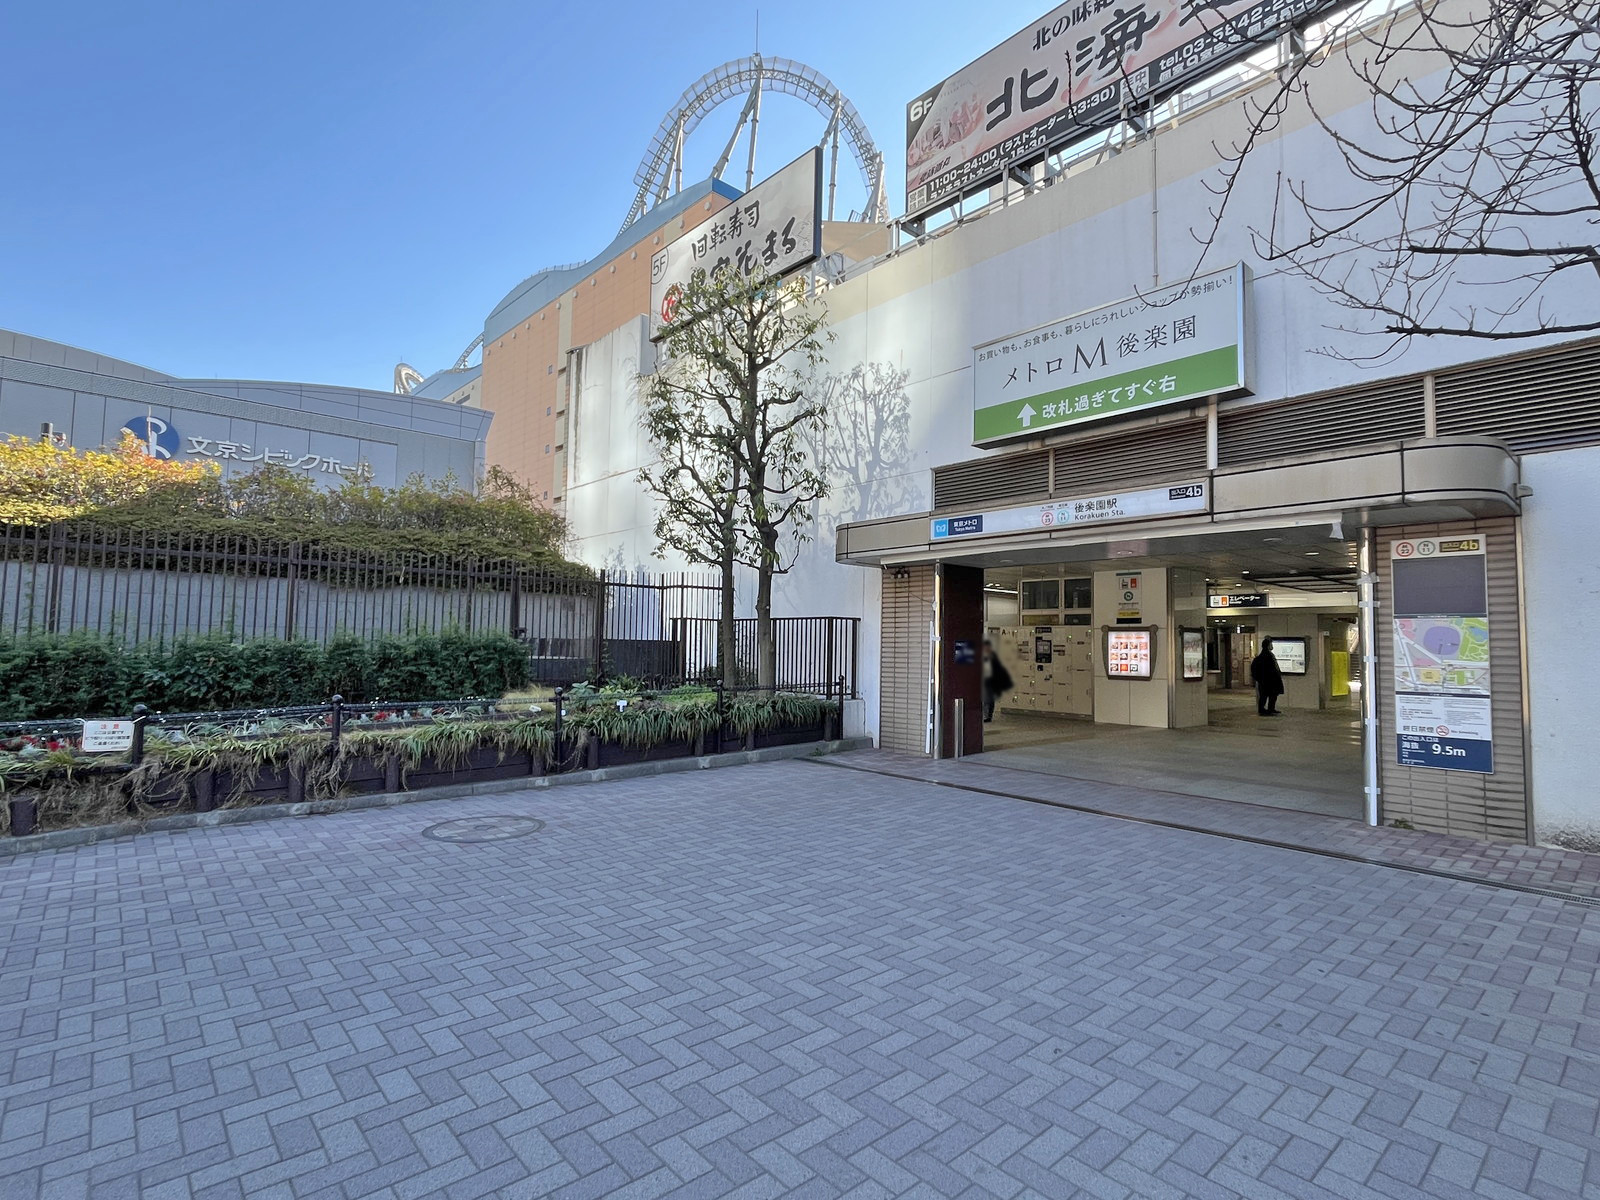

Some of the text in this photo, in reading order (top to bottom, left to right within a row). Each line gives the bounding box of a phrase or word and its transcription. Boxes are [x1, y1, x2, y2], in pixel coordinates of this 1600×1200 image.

[909, 97, 933, 123] 6F
[691, 200, 760, 261] 回転寿司
[652, 254, 667, 277] 5F
[1042, 375, 1177, 419] 改札過ぎてすぐ右
[187, 435, 376, 478] 文京シビックホール
[1186, 485, 1202, 497] 4b
[1074, 497, 1118, 514] 後楽園駅
[953, 518, 978, 528] 東京メトロ
[1074, 511, 1110, 521] Korakuen
[1460, 540, 1479, 551] 4b
[1431, 743, 1467, 757] 9.5m
